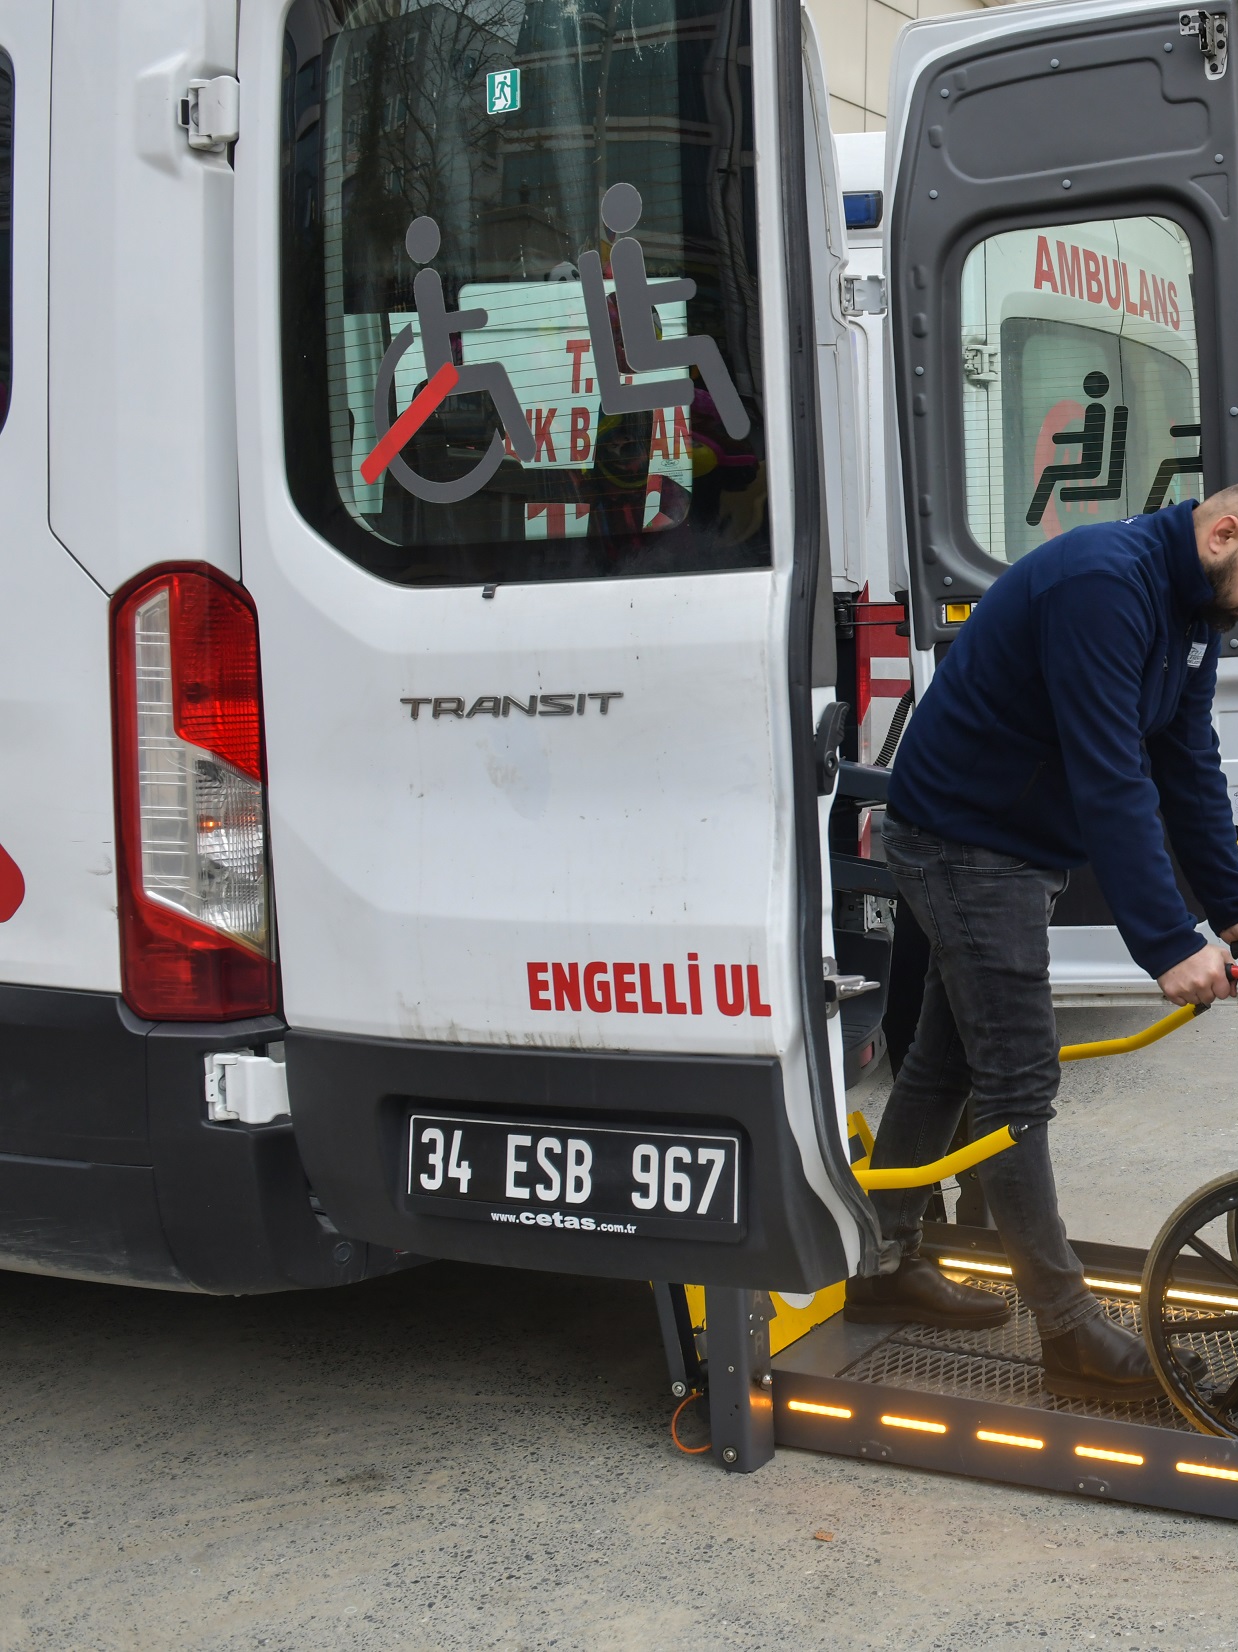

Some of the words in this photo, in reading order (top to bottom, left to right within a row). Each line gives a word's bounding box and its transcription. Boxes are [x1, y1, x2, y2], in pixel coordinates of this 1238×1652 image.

[1033, 235, 1180, 331] AMBULANS
[400, 691, 624, 720] TRANSIT
[526, 952, 703, 1015] ENGELLİ
[713, 963, 772, 1017] UL
[419, 1127, 472, 1193] 34
[505, 1133, 593, 1204] ESB
[631, 1143, 726, 1215] 967
[490, 1211, 637, 1234] www.cetas.com.tr
